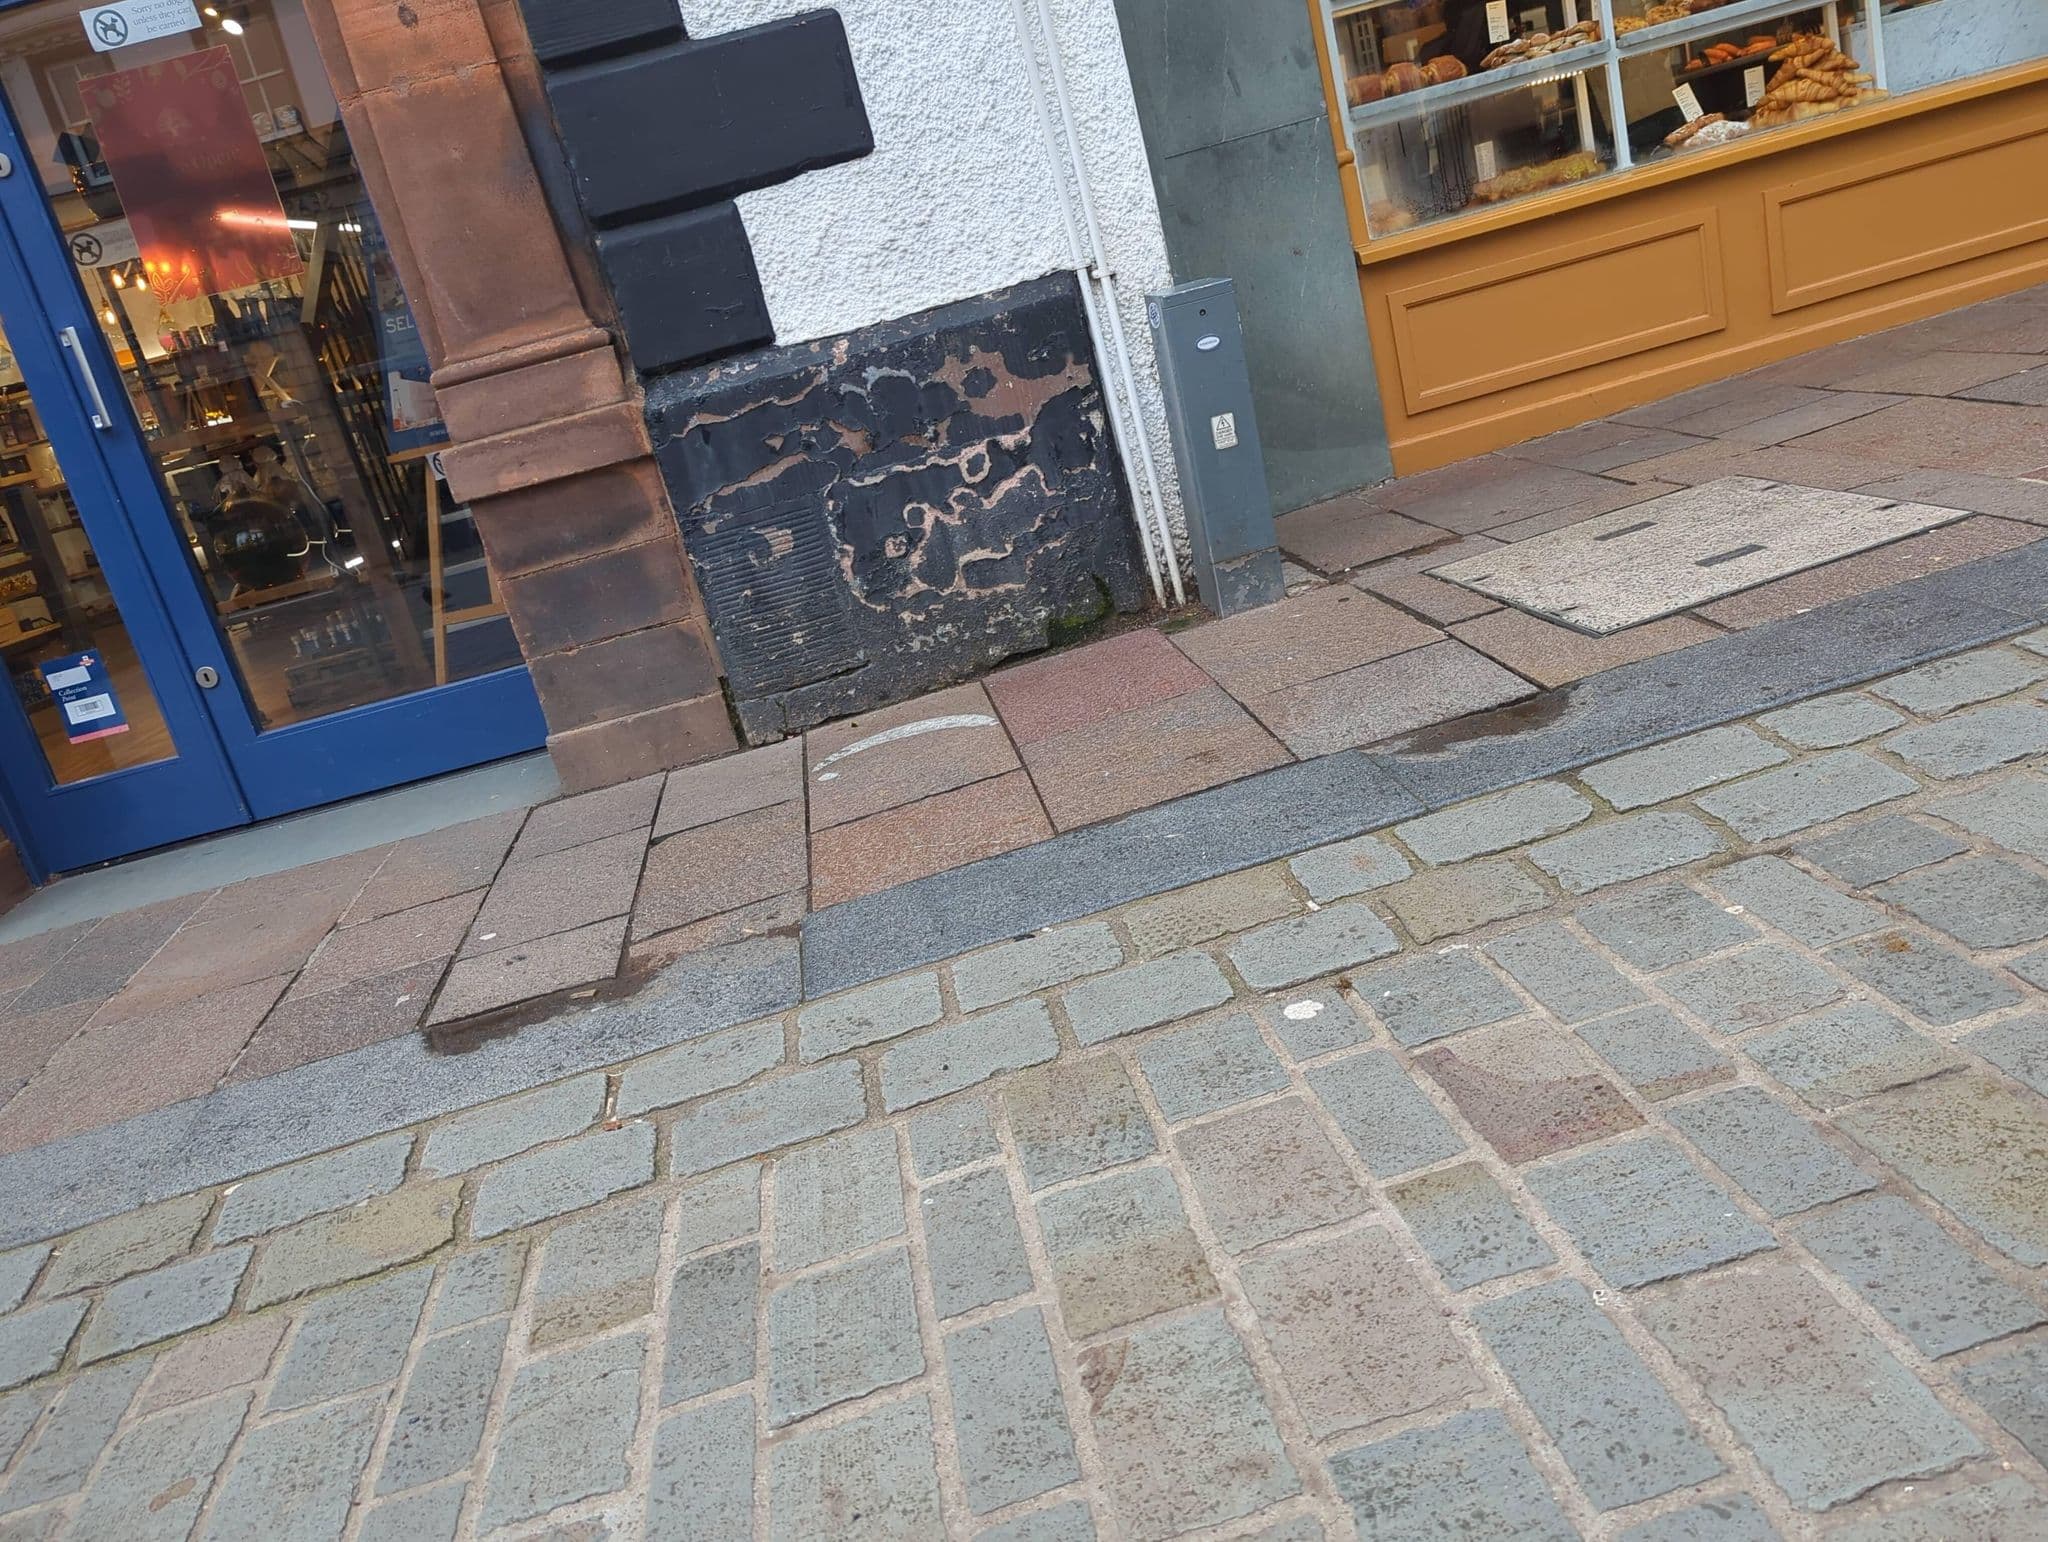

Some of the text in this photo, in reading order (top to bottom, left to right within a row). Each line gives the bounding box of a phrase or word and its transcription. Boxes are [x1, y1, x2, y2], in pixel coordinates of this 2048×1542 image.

[131, 5, 152, 14] Sorry
[132, 15, 158, 25] unless
[159, 9, 175, 19] they
[146, 18, 186, 33] be carried
[58, 686, 87, 696] Collection
